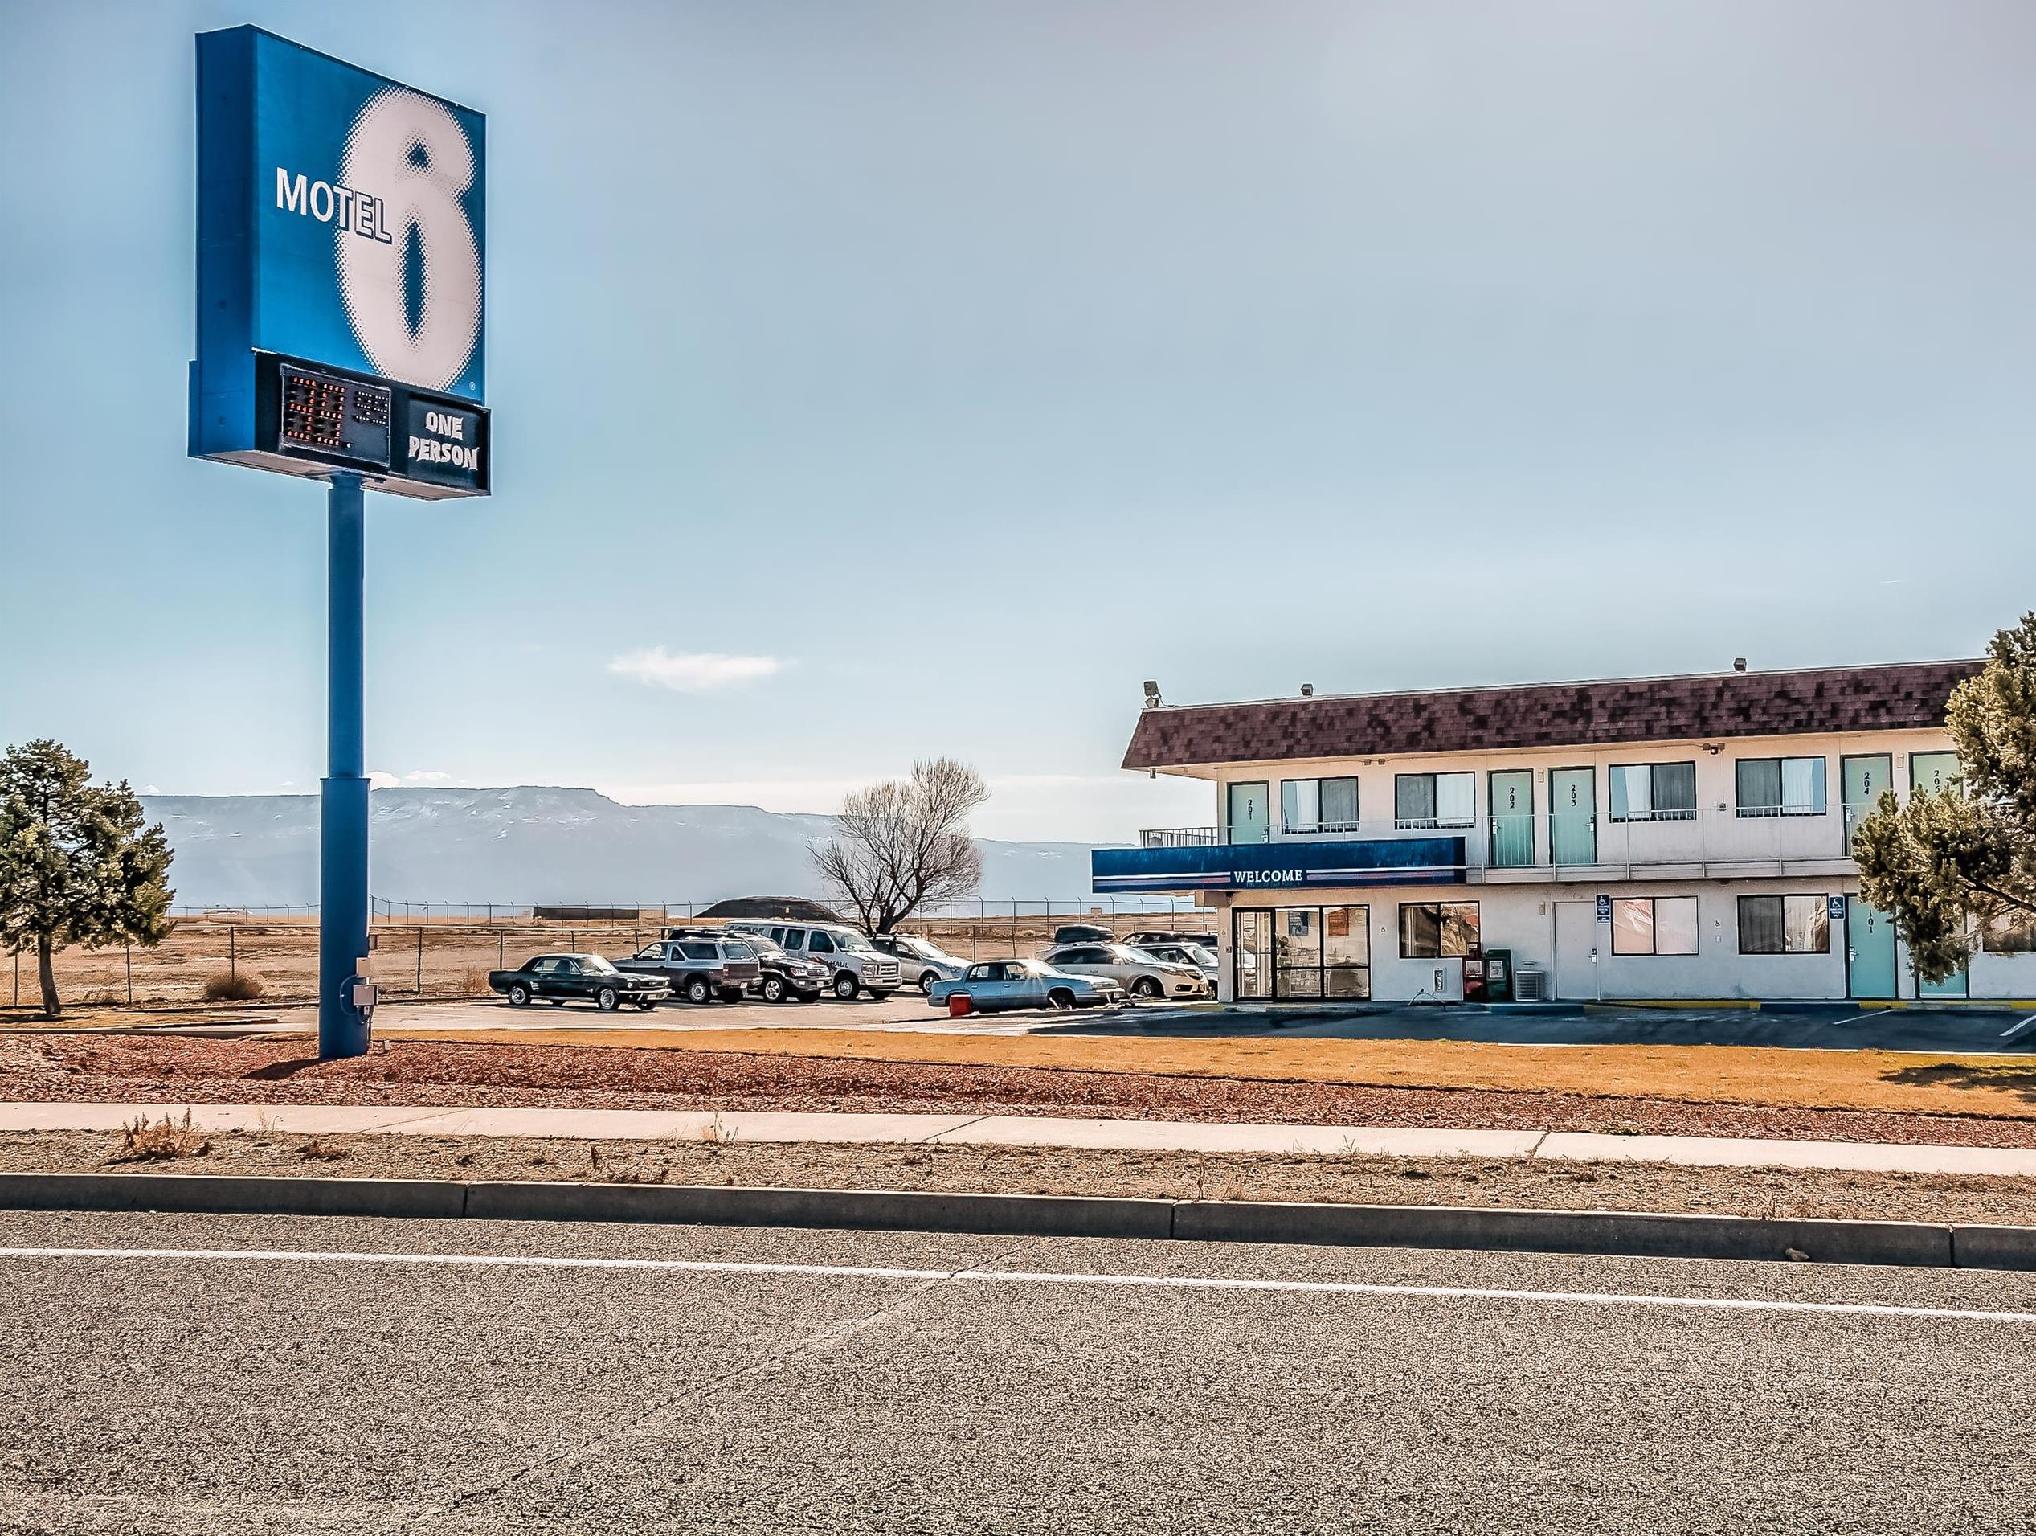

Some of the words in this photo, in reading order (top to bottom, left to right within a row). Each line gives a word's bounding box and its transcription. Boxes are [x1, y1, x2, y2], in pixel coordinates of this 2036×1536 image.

[275, 166, 393, 244] MOTEL
[336, 86, 482, 392] 6
[425, 411, 464, 440] ONE
[408, 435, 480, 471] PERSON
[1863, 771, 1871, 795] 204
[1233, 869, 1303, 883] WELCOME
